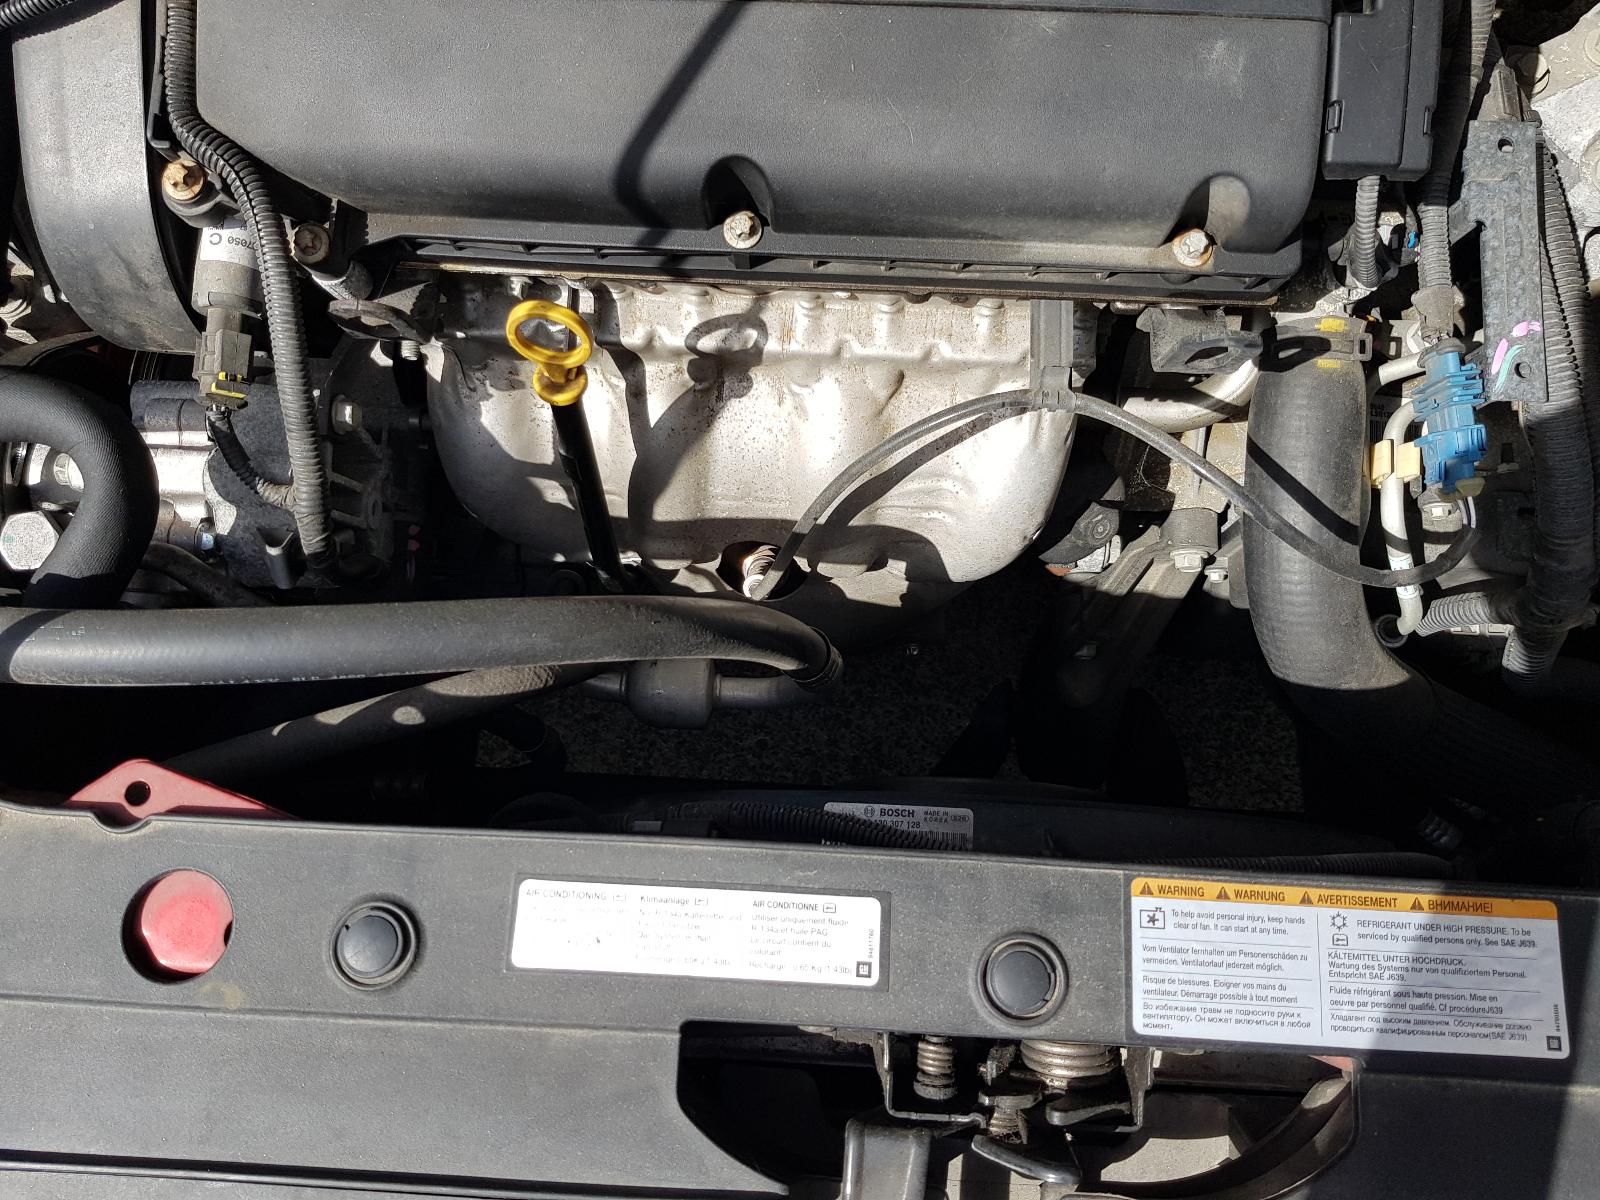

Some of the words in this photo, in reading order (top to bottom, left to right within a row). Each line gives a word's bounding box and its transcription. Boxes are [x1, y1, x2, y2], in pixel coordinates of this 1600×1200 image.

[879, 808, 915, 818] BOSCH
[907, 821, 921, 829] 128
[1157, 884, 1205, 897] WARNING
[1234, 889, 1285, 901] WARNUNG
[1317, 894, 1398, 908] AVERTISSEMENT
[1428, 899, 1493, 913] ВНИМАНИЕ!
[1172, 909, 1180, 917] To
[1181, 909, 1195, 919] help
[1197, 911, 1215, 919] avoid
[1216, 912, 1244, 922] personal
[1246, 913, 1266, 923] injury,
[1267, 914, 1283, 924] keep
[1285, 916, 1306, 925] hands
[811, 928, 828, 937] PAG
[1174, 921, 1190, 930] clear
[1191, 922, 1199, 930] of
[1199, 923, 1212, 931] fan.
[1234, 925, 1249, 933] start
[1250, 926, 1257, 934] at
[1259, 927, 1271, 936] any
[1272, 927, 1289, 935] time.
[1357, 920, 1411, 930] REFRIGERANT
[1414, 922, 1441, 932] UNDER
[1443, 924, 1463, 933] HIGH
[1465, 925, 1509, 935] PRESSURE.
[1511, 928, 1521, 936] To
[1521, 928, 1531, 936] be
[1357, 932, 1389, 941] serviced
[1390, 933, 1400, 944] by
[1401, 934, 1433, 944] qualified
[1434, 937, 1464, 946] persons
[1484, 938, 1499, 946] See
[1501, 939, 1516, 947] SAE
[1142, 944, 1157, 953] Vom
[1158, 945, 1190, 954] Ventilator
[1191, 947, 1225, 956] fernhalten
[1238, 949, 1299, 961] Personenschäden
[1328, 950, 1381, 962] KÄLTEMITTEL
[1383, 955, 1410, 963] UNTER
[1181, 958, 1224, 969] Ventilatorlauf
[1225, 960, 1254, 970] jederzeit
[1255, 962, 1284, 972] möglich.
[1328, 961, 1357, 971] Wartung
[1361, 962, 1375, 970] des
[1377, 963, 1410, 974] Systems
[1411, 965, 1424, 973] nur
[1425, 966, 1439, 974] von
[1441, 967, 1491, 977] qualifiziertem
[1143, 976, 1166, 985] Risque
[1178, 978, 1212, 987] blessures.
[1256, 982, 1276, 990] mains
[1328, 971, 1366, 980] Entspricht
[1368, 972, 1385, 980] SAE
[1387, 973, 1407, 981] J639.
[1180, 989, 1218, 1000] Démarrage
[1219, 992, 1248, 1001] possible
[1255, 994, 1269, 1003] tout
[1270, 995, 1298, 1004] moment
[1329, 985, 1352, 995] Fluide
[1353, 987, 1391, 998] réfrigérant
[1393, 990, 1411, 998] sous
[1412, 990, 1433, 999] haute
[1434, 991, 1467, 1001] pression.
[1469, 993, 1487, 1002] Mise
[1143, 1002, 1154, 1010] Во
[1200, 1006, 1222, 1014] травм
[1235, 1008, 1276, 1017] подносите
[1277, 1011, 1295, 1020] руки
[1329, 999, 1355, 1007] oeuvre
[1356, 1000, 1369, 1008] par
[1370, 1001, 1407, 1010] personnel
[1194, 1014, 1206, 1022] Он
[1207, 1016, 1233, 1024] может
[1286, 1019, 1311, 1029] любой
